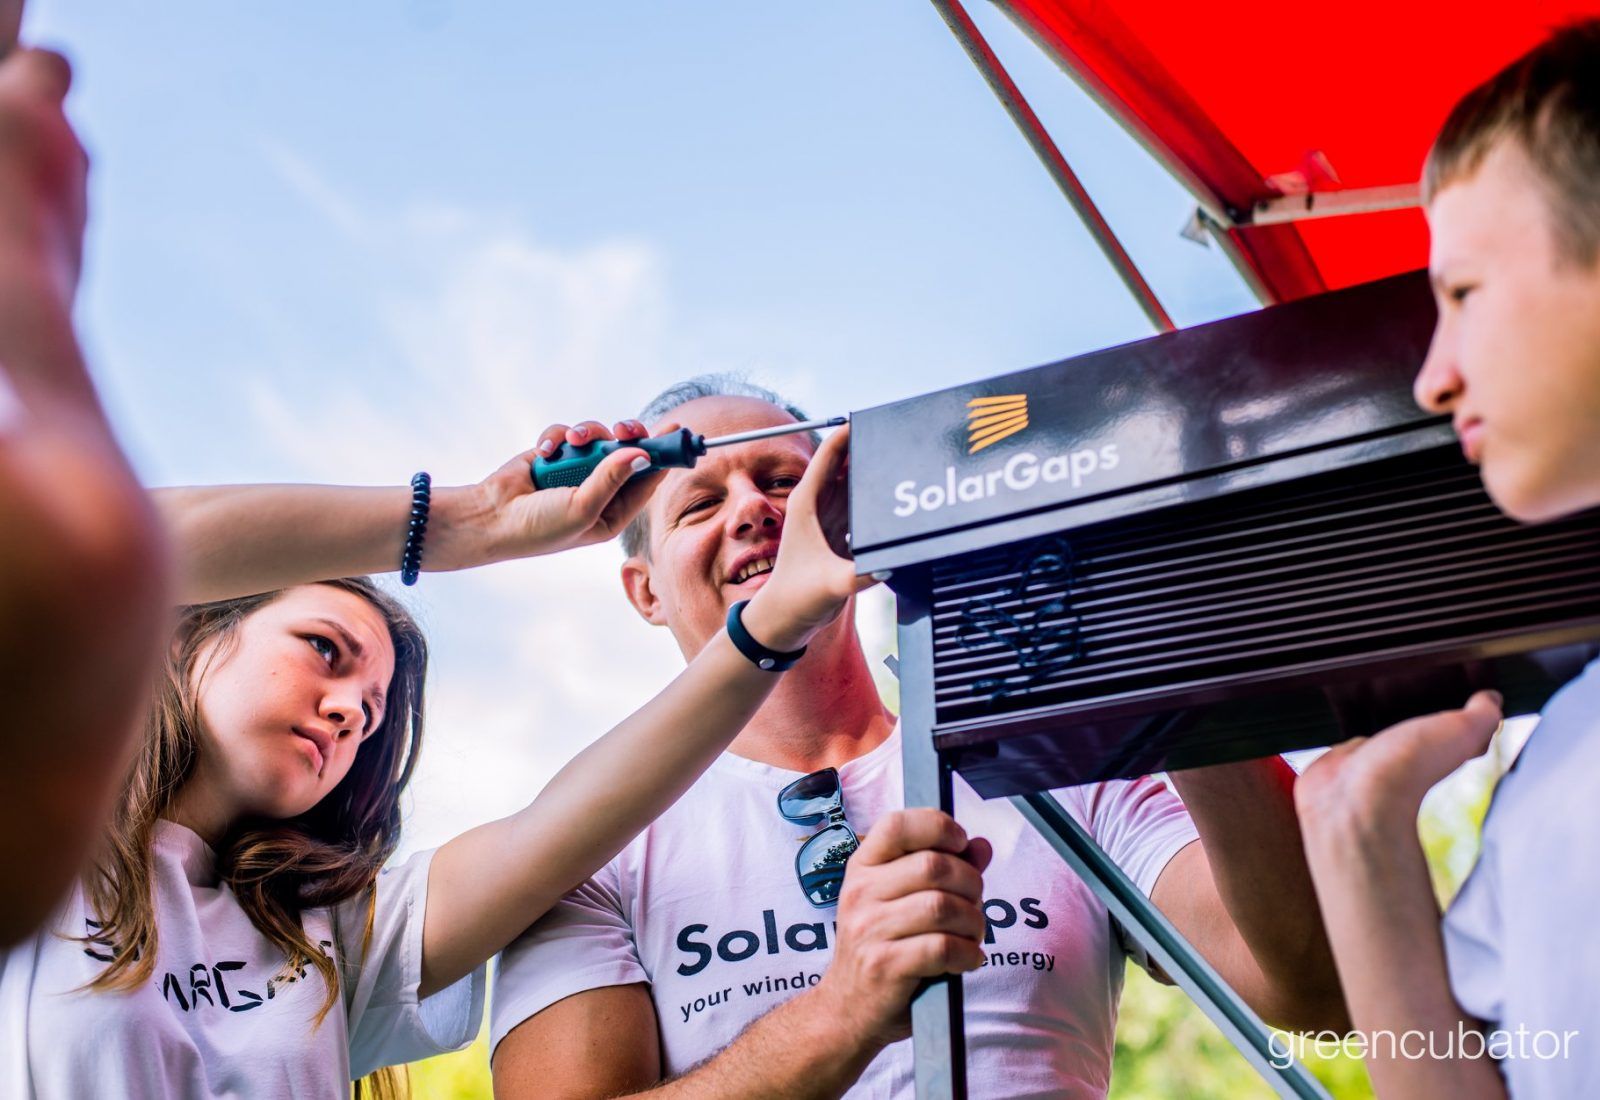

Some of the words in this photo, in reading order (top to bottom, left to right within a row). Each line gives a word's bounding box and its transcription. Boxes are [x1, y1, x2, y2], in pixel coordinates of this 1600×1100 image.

[893, 444, 1120, 517] SolarGaps
[680, 987, 732, 1023] your
[742, 971, 822, 997] windo
